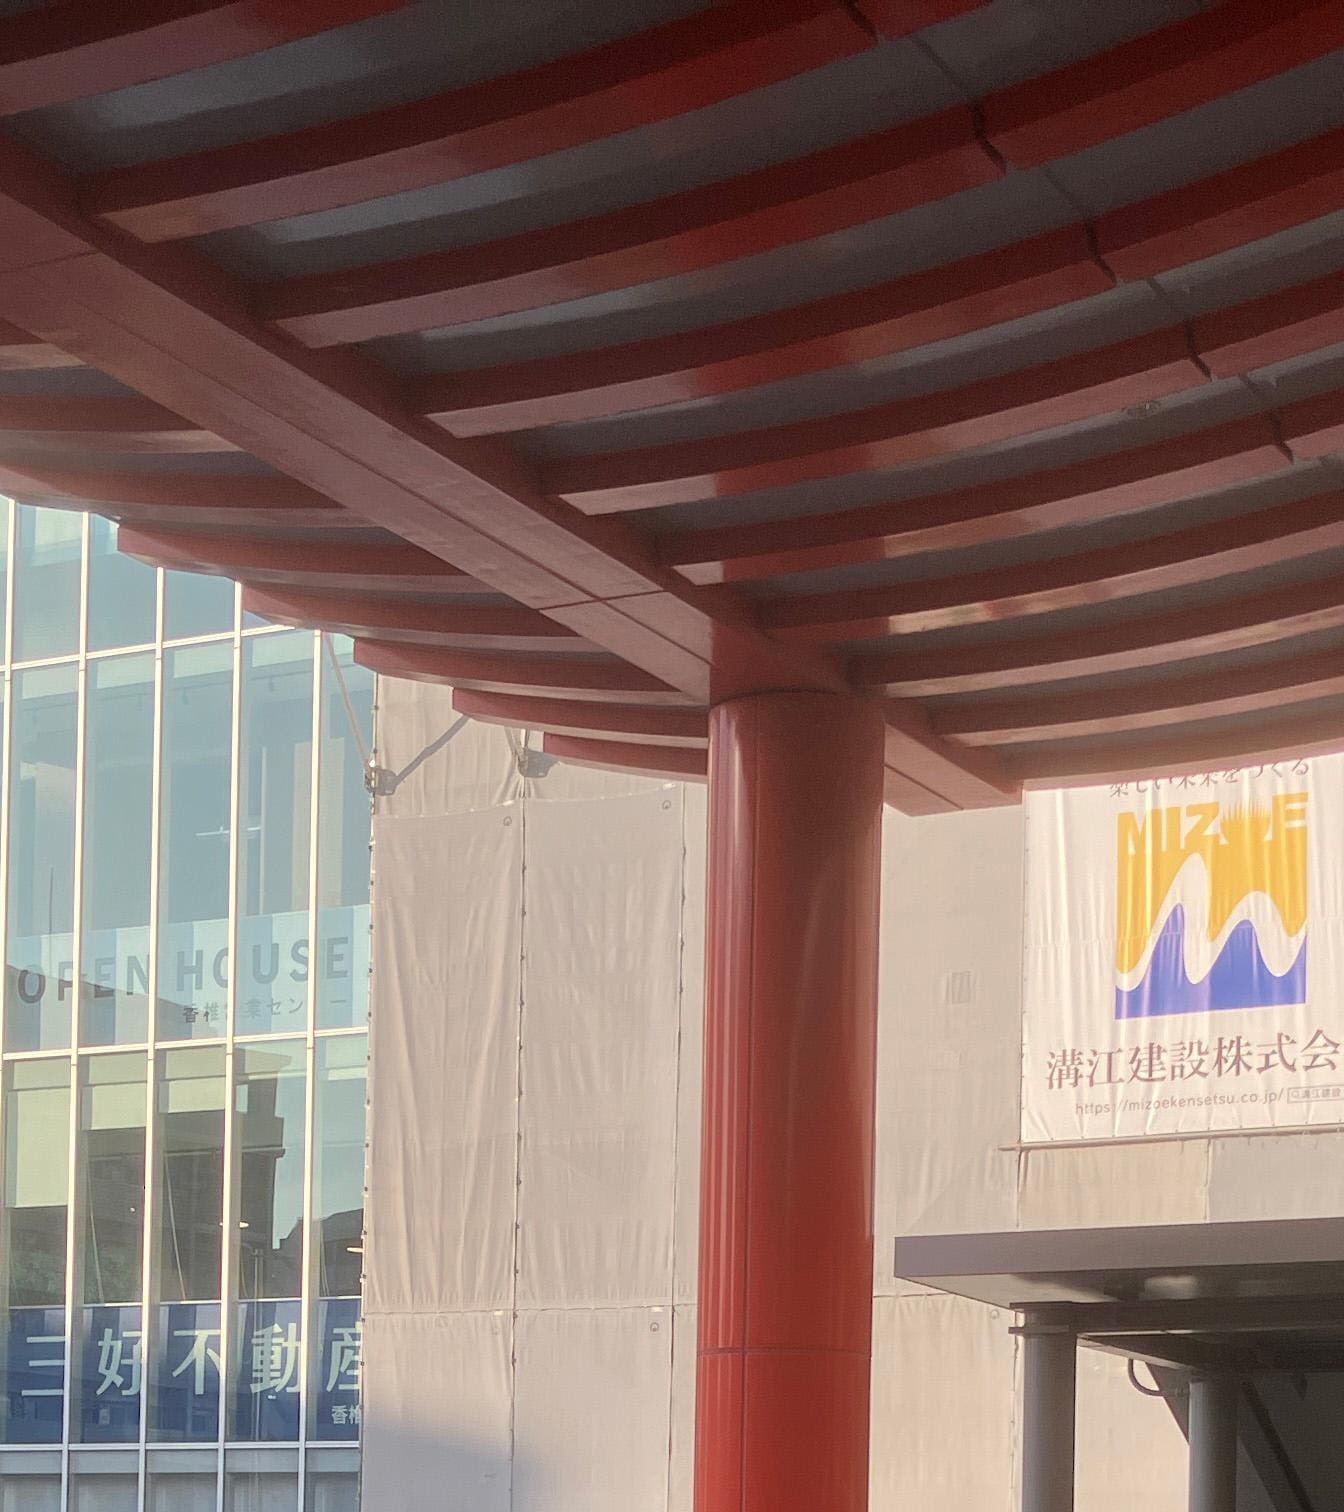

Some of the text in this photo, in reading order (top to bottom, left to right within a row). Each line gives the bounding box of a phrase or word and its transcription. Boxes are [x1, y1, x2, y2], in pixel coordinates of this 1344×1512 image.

[17, 936, 349, 1004] OPEN HOUSE
[1075, 1088, 1285, 1115] https://mizoekensetsu.co.jp/
[21, 1322, 361, 1397] 三好不動産
